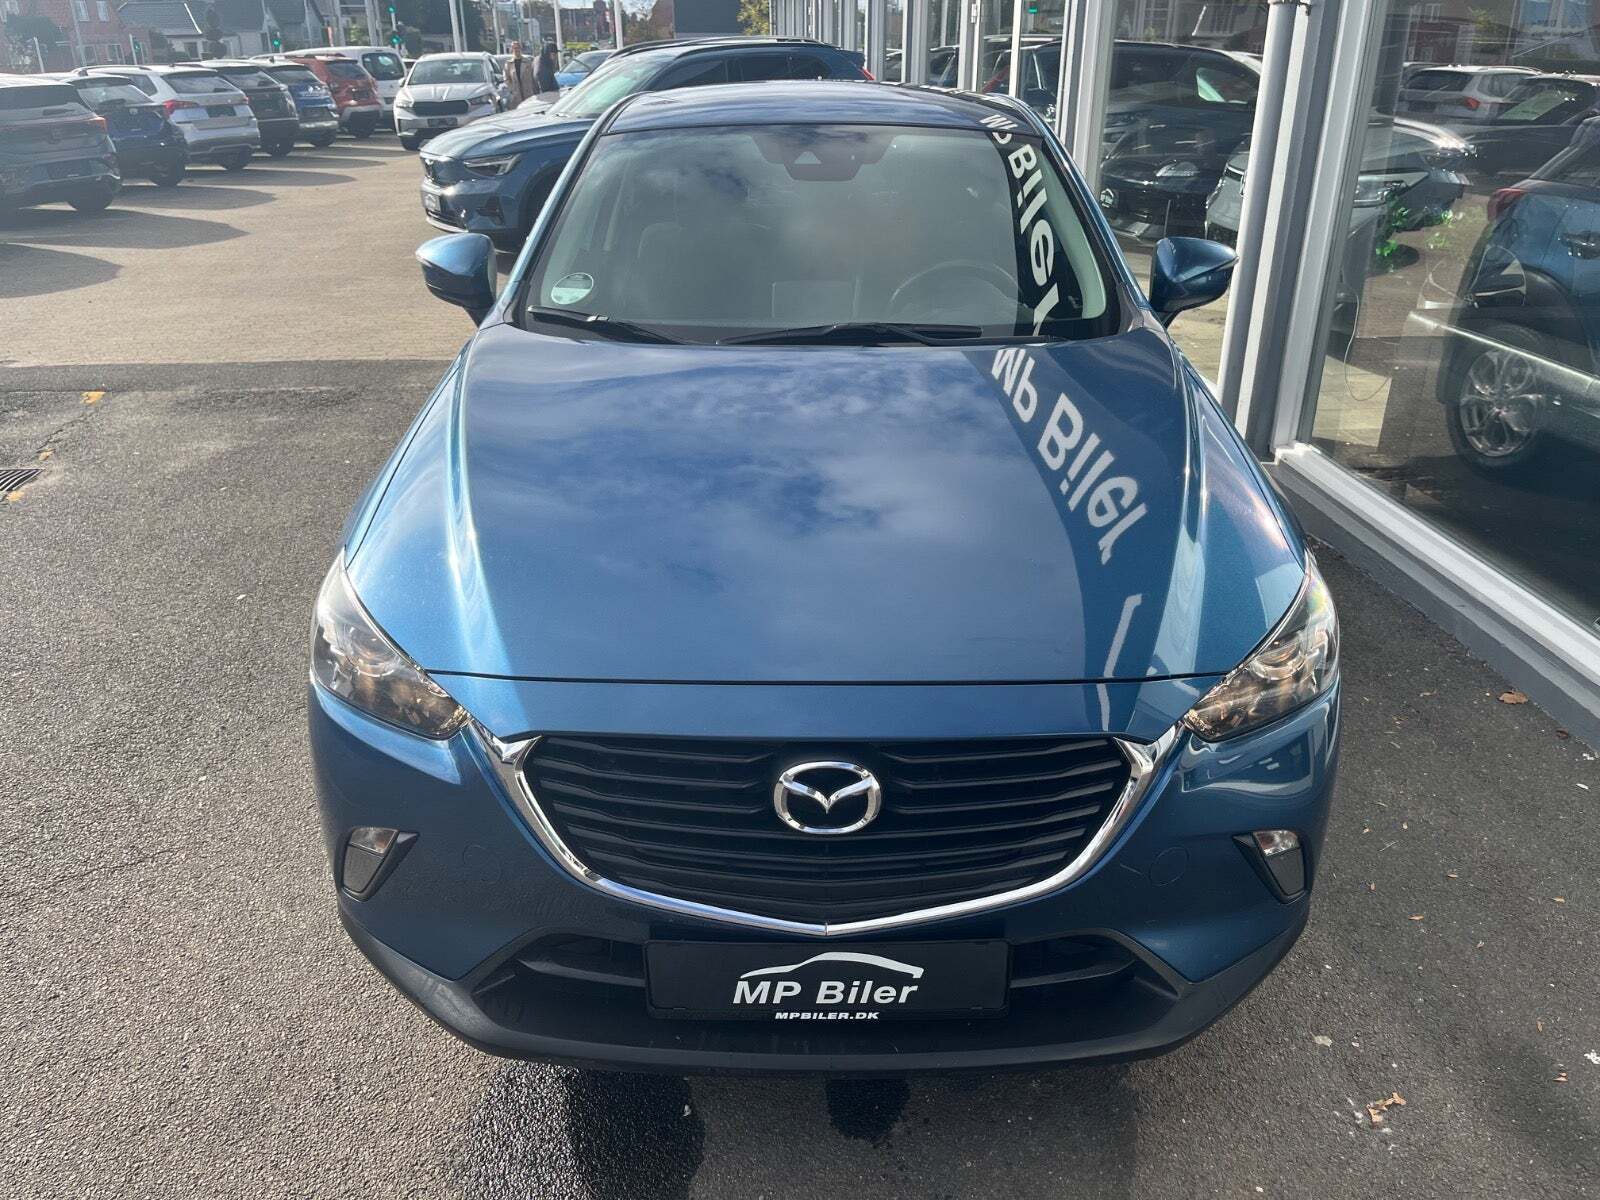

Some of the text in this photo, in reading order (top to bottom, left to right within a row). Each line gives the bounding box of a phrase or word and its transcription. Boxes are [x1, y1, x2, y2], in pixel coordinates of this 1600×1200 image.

[733, 980, 919, 1005] MP Biler
[774, 1011, 880, 1020] MPBILER.DK
